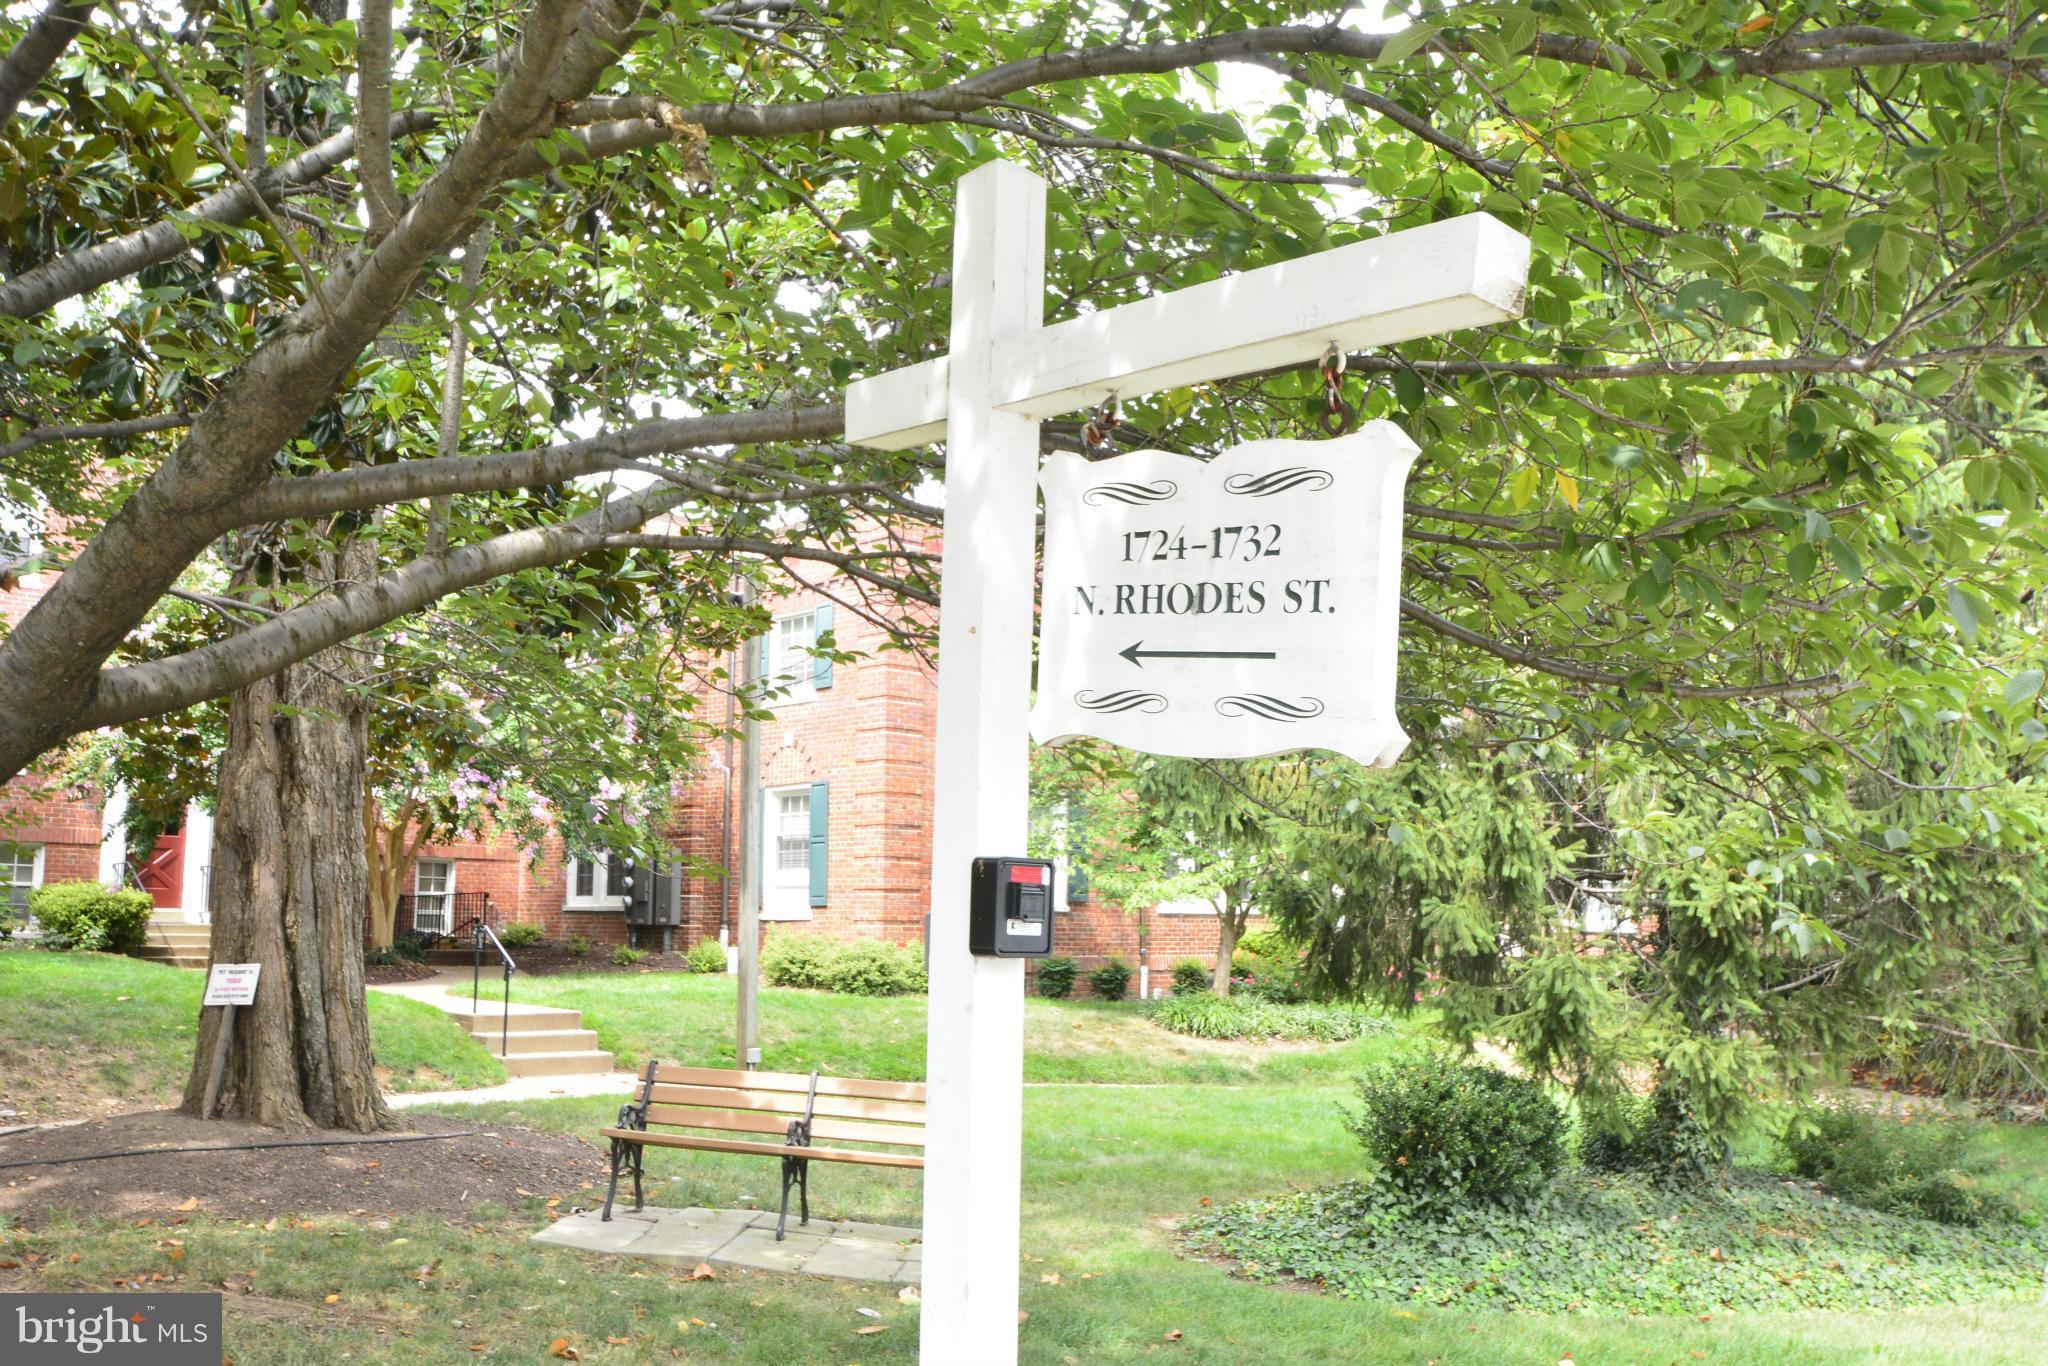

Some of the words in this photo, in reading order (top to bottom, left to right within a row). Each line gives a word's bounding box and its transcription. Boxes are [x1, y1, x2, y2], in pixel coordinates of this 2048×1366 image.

[1121, 524, 1282, 562] 1724-1732
[1073, 585, 1105, 615] N.
[1112, 580, 1266, 615] RHODES
[1282, 578, 1336, 614] ST.
